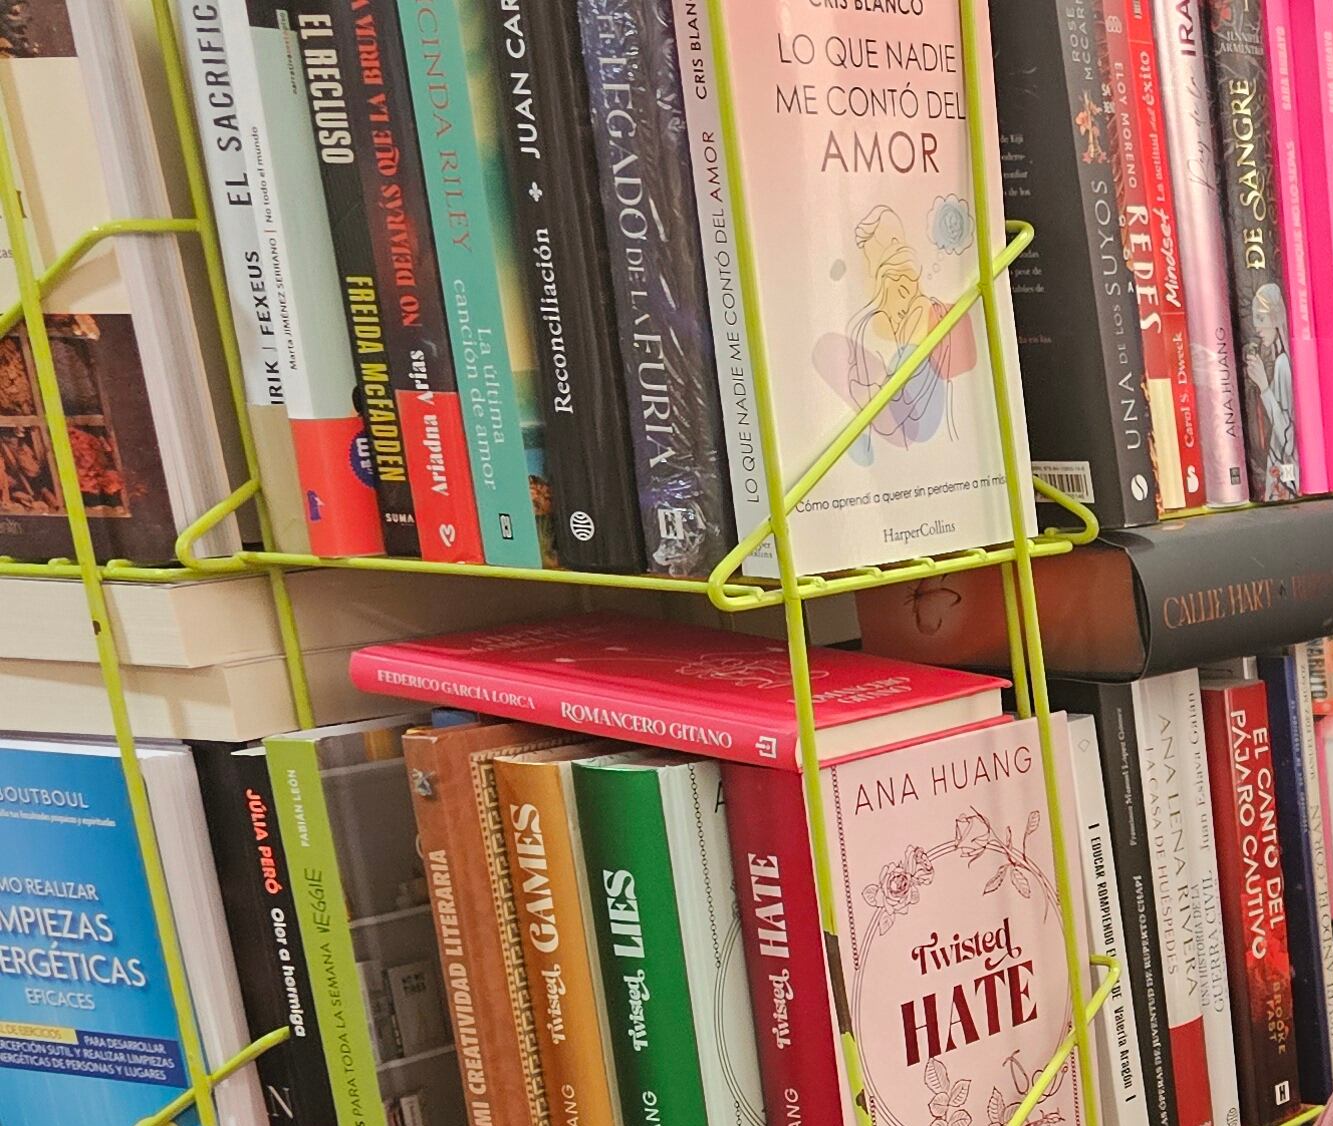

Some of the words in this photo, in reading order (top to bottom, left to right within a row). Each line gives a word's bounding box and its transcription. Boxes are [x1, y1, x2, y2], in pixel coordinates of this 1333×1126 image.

[298, 14, 334, 40] EL
[777, 32, 816, 66] LO
[825, 35, 880, 70] QUE
[885, 41, 958, 74] NADIE
[303, 48, 354, 165] RECLUSO
[510, 72, 541, 159] JUAN
[224, 171, 253, 207] EL
[821, 130, 940, 174] AMOR
[1229, 78, 1268, 223] SANGRE
[439, 150, 473, 252] RILEY
[1126, 204, 1162, 334] REDES
[1246, 226, 1267, 271] DE
[244, 250, 274, 336] FEXEUS
[533, 227, 574, 414] Reconciliación
[883, 519, 957, 544] HarperCollins
[560, 701, 667, 740] ROMANCERO
[667, 720, 734, 751] GITANO
[1230, 708, 1257, 828] PÁJARO
[1252, 726, 1269, 760] EL
[854, 772, 919, 816] ANA
[930, 745, 1033, 796] HUANG
[1257, 766, 1280, 869] CANTO
[26, 878, 100, 902] REALIZAR
[509, 802, 560, 954] GAMES
[602, 868, 646, 960] LIES
[747, 852, 791, 959] HATE
[1241, 834, 1267, 961] CAUTIVO
[1265, 875, 1285, 930] DEL
[910, 916, 1023, 976] Twisted
[540, 963, 567, 1045] Twisted
[623, 968, 651, 1052] Twisted
[767, 967, 795, 1050] Twisted
[899, 959, 1039, 1067] HATE
